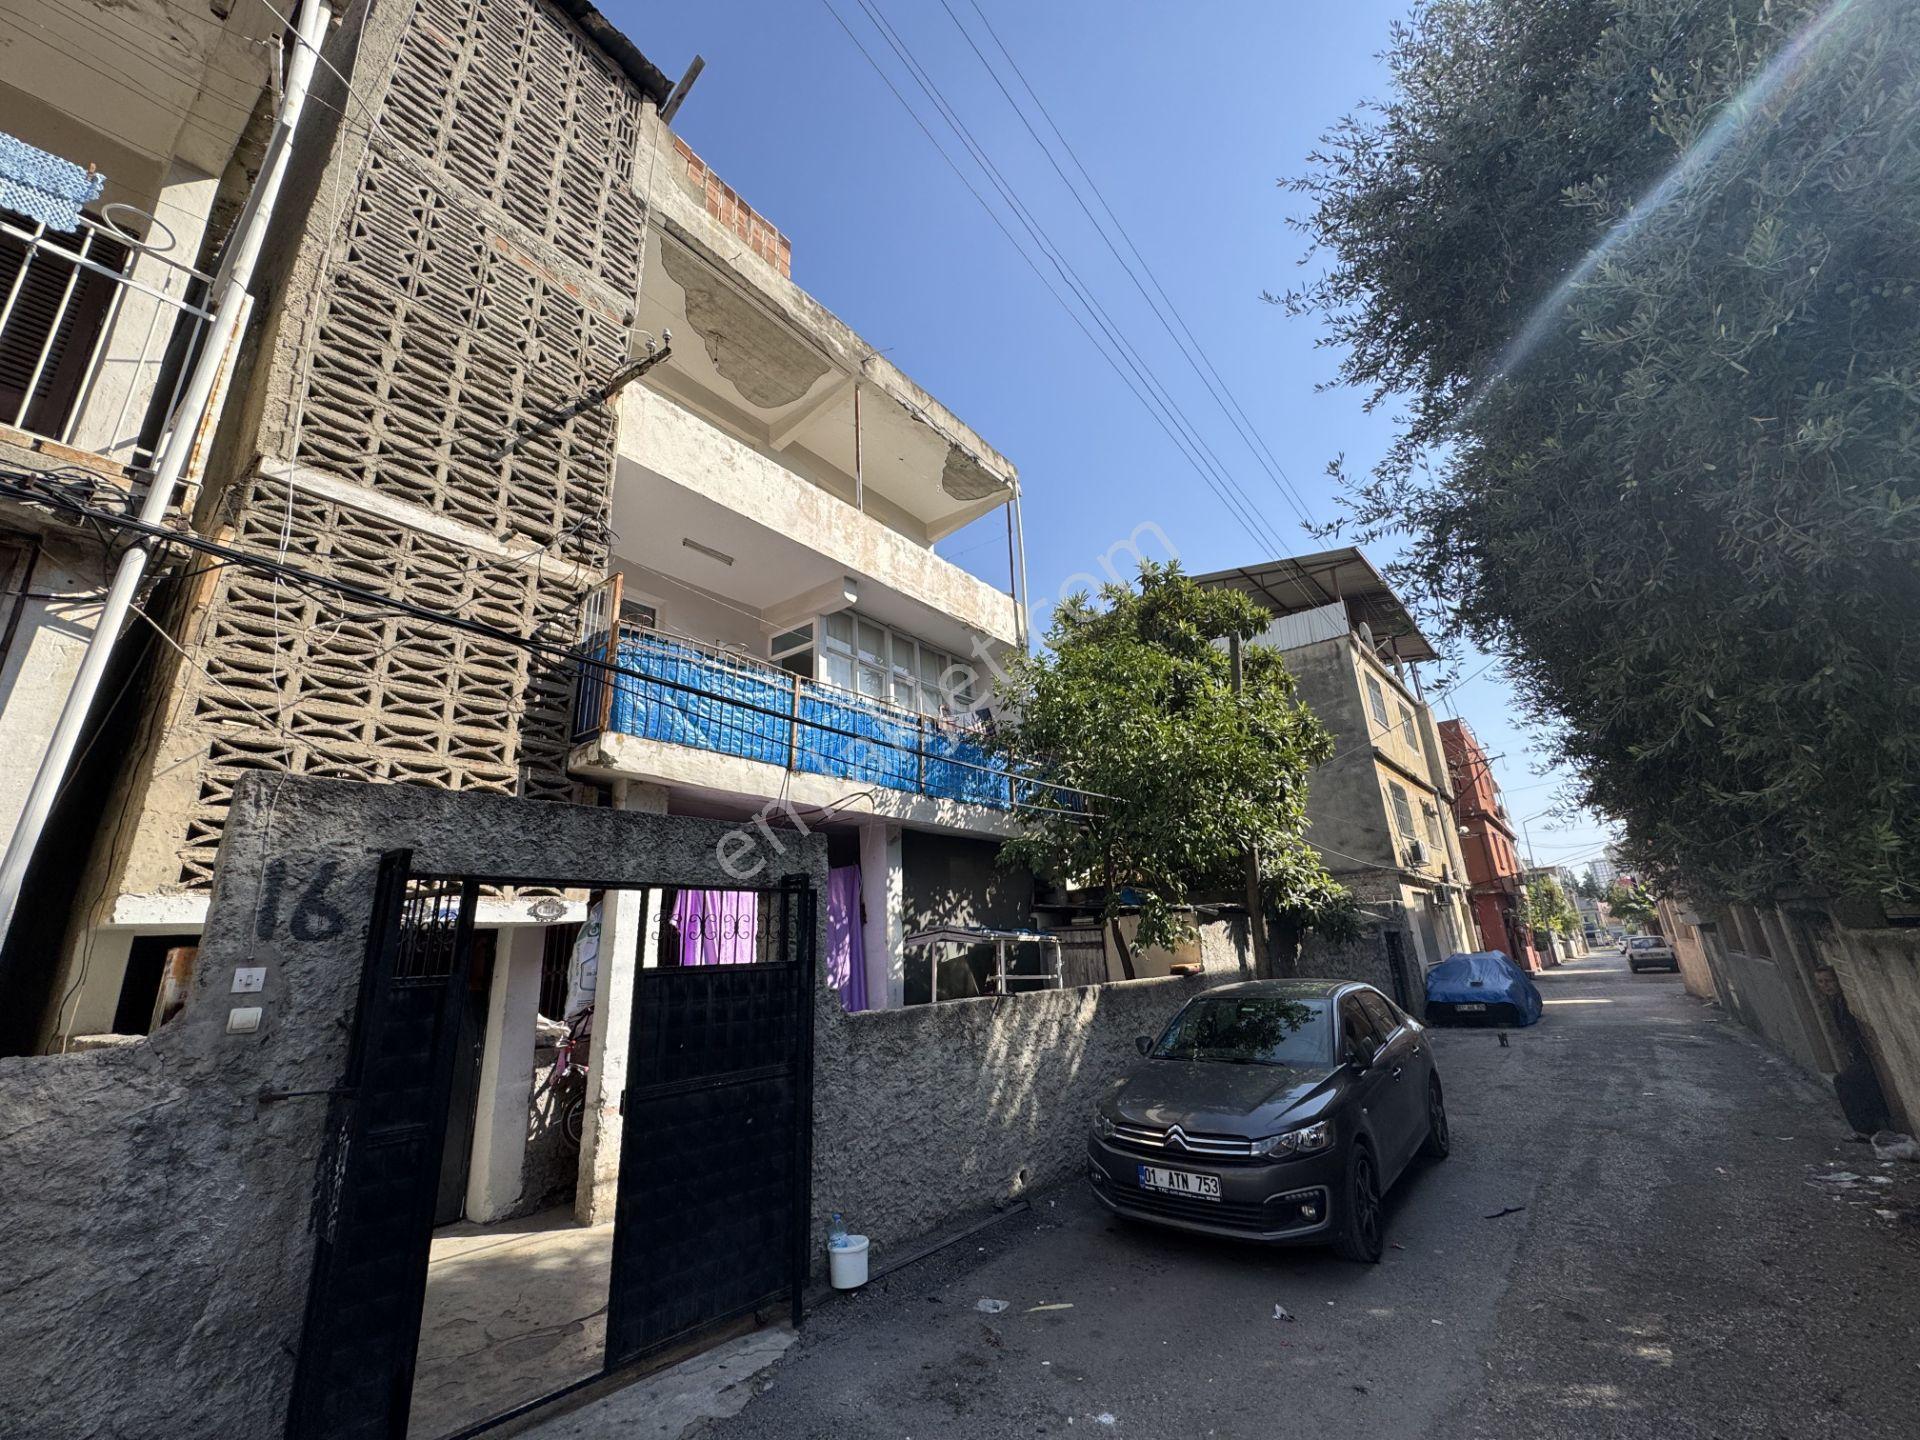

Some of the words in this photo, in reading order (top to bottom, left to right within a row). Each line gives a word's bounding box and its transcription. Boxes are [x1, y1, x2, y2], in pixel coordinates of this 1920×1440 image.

[257, 857, 344, 942] 16
[1144, 1168, 1158, 1185] 01
[1168, 1171, 1190, 1190] ATN
[1196, 1175, 1219, 1195] 753
